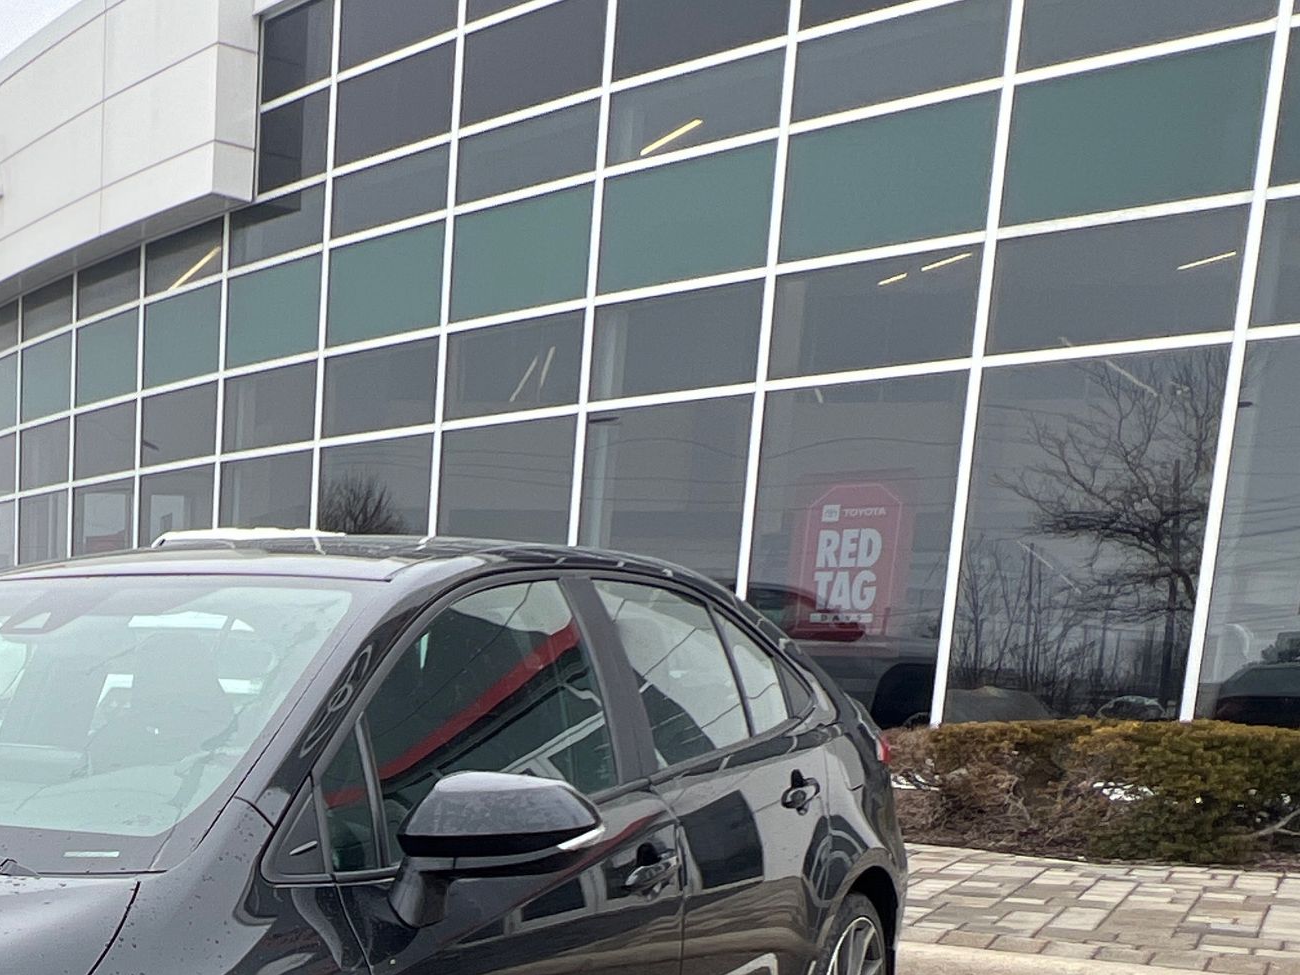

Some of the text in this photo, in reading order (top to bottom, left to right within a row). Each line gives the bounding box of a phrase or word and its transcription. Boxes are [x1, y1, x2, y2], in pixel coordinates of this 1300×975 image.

[843, 507, 887, 518] TOYOTA
[815, 528, 882, 568] RED
[814, 570, 877, 611] TAG
